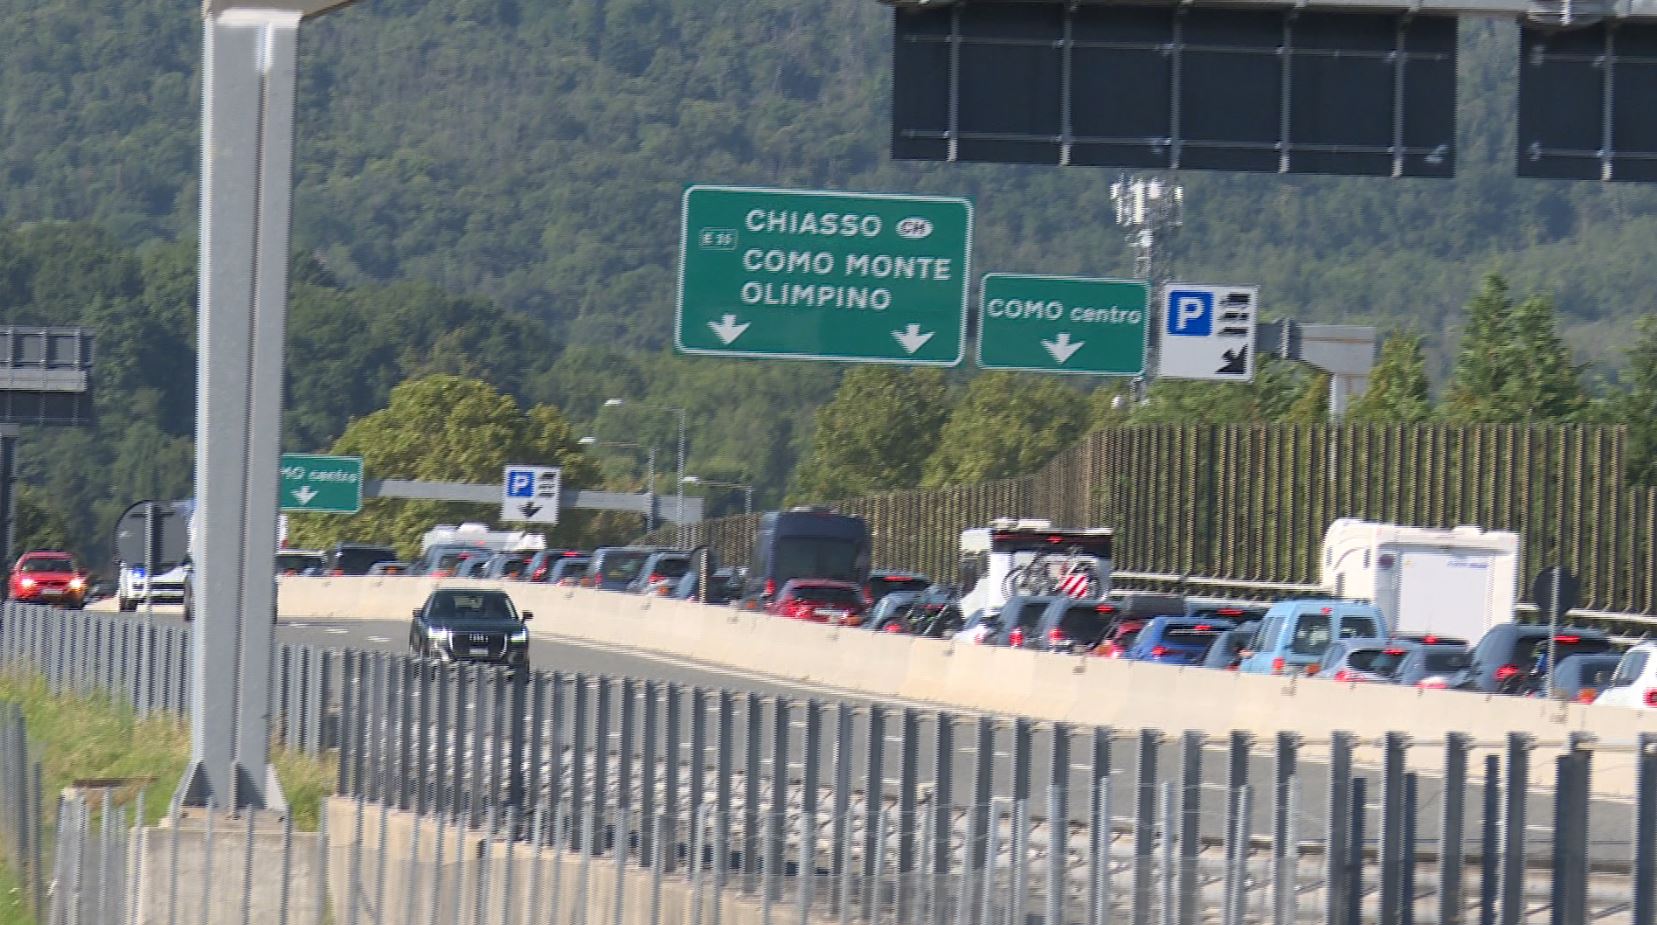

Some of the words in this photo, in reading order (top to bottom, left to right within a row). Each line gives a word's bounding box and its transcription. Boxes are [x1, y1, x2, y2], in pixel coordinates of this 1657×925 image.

[746, 209, 883, 238] CHIASSO
[702, 232, 714, 246] E
[743, 249, 835, 274] COMO
[845, 255, 952, 280] MONTE
[741, 281, 892, 310] OLIMPINO
[987, 298, 1063, 321] COMO
[1070, 306, 1142, 324] centro
[1176, 296, 1204, 331] P
[514, 474, 529, 493] P
